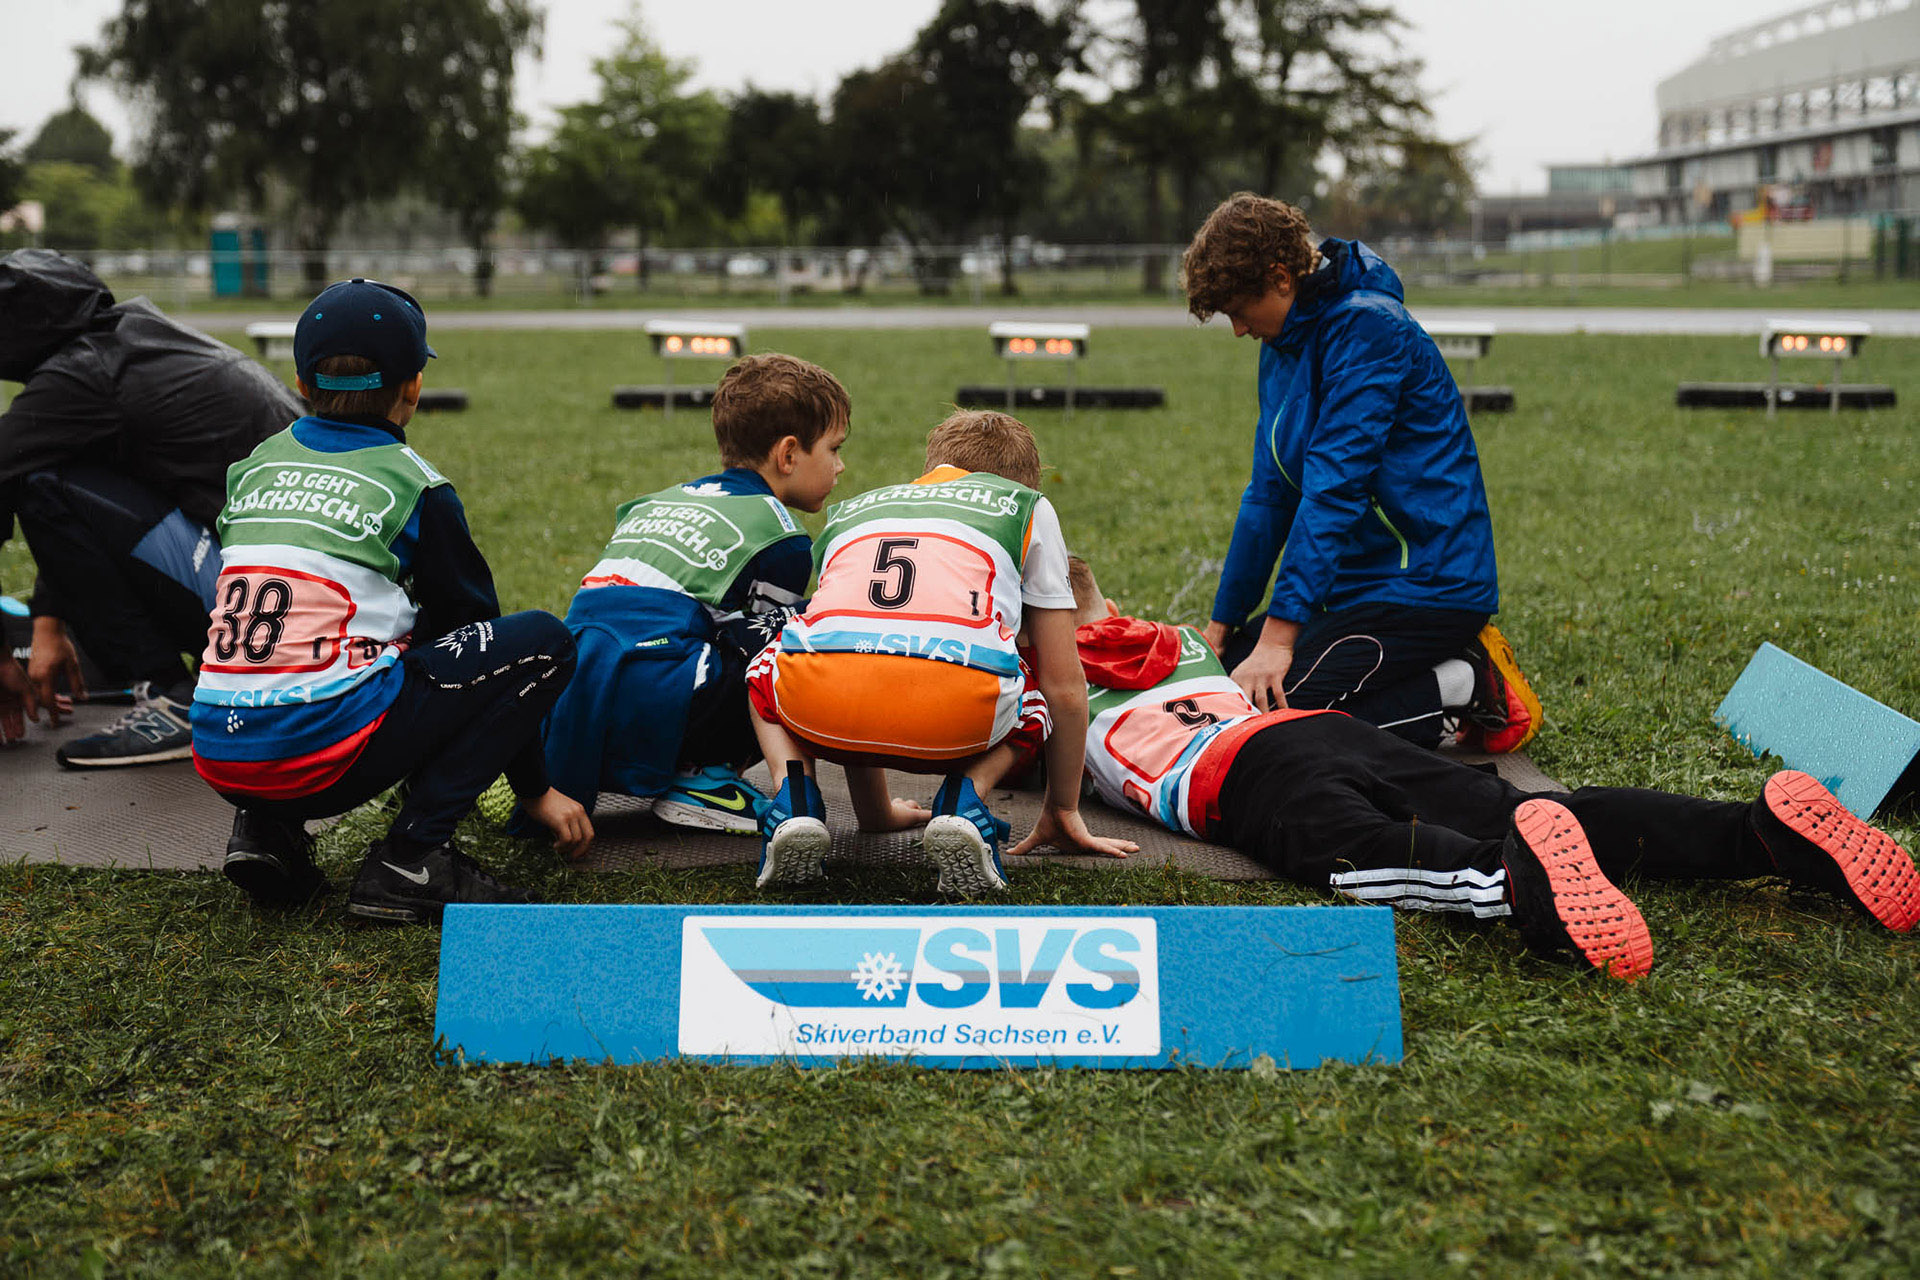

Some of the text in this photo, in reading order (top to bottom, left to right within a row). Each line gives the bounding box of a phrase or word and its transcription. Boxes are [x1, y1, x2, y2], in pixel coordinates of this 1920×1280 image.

[273, 470, 360, 497] SO GEHT
[647, 506, 717, 532] SO GEHT
[867, 538, 919, 610] 5
[968, 589, 980, 617] 1
[215, 576, 293, 664] 38
[880, 633, 966, 662] SVS
[916, 928, 1141, 1009] SVS
[796, 1023, 1121, 1045] Skiverband Sachsen e.V.
